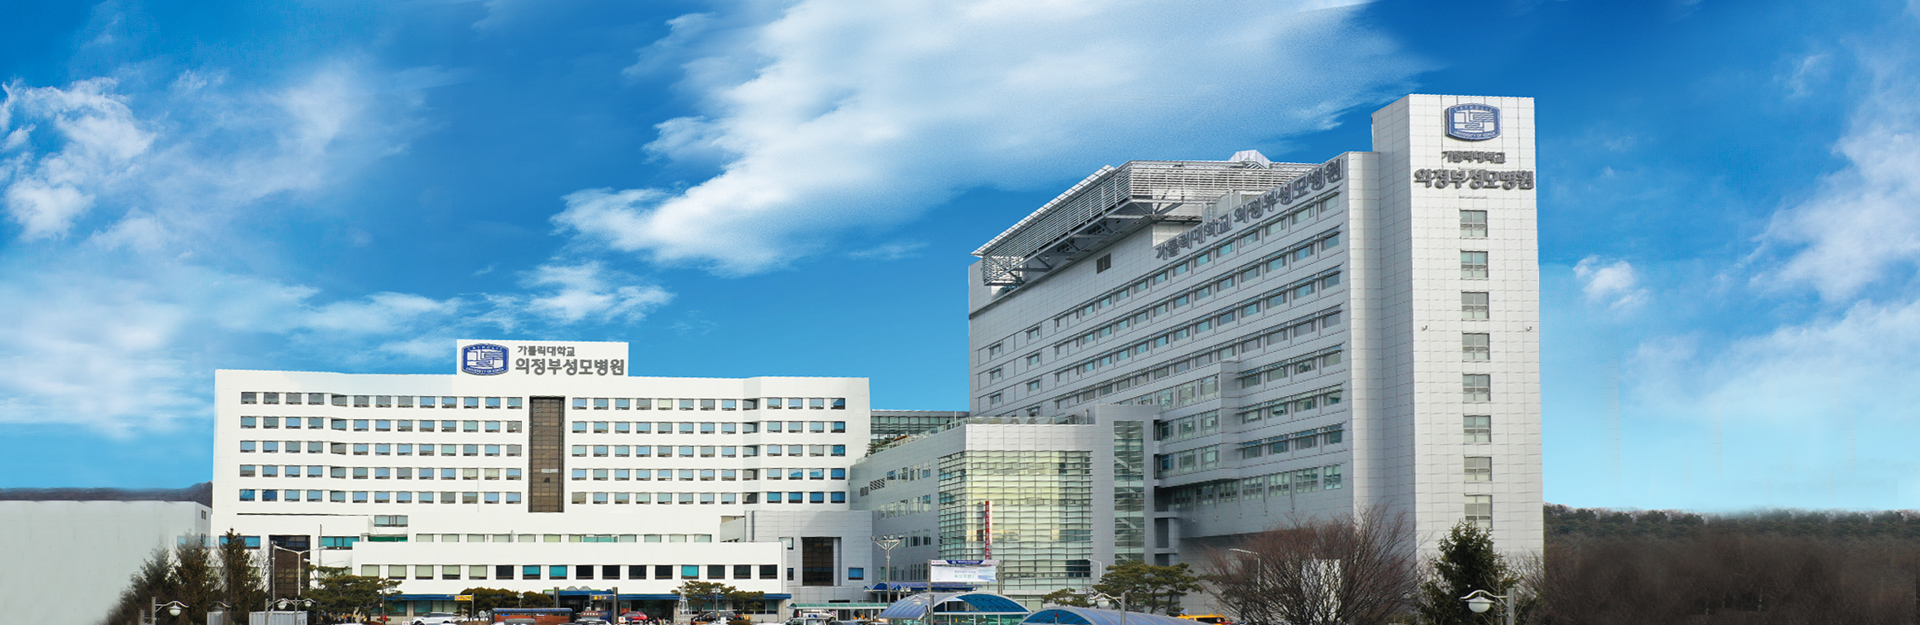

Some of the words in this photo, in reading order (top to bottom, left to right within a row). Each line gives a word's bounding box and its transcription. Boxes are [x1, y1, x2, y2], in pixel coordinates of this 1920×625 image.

[1441, 150, 1506, 164] 가톨릭대학교
[1413, 168, 1535, 190] 의정부성모병원
[1155, 212, 1233, 260] 가톨릭대학교
[1233, 158, 1344, 224] 의정부성모병원
[517, 345, 576, 357] 가톨릭대학교
[515, 358, 625, 376] 의정부성모병원
